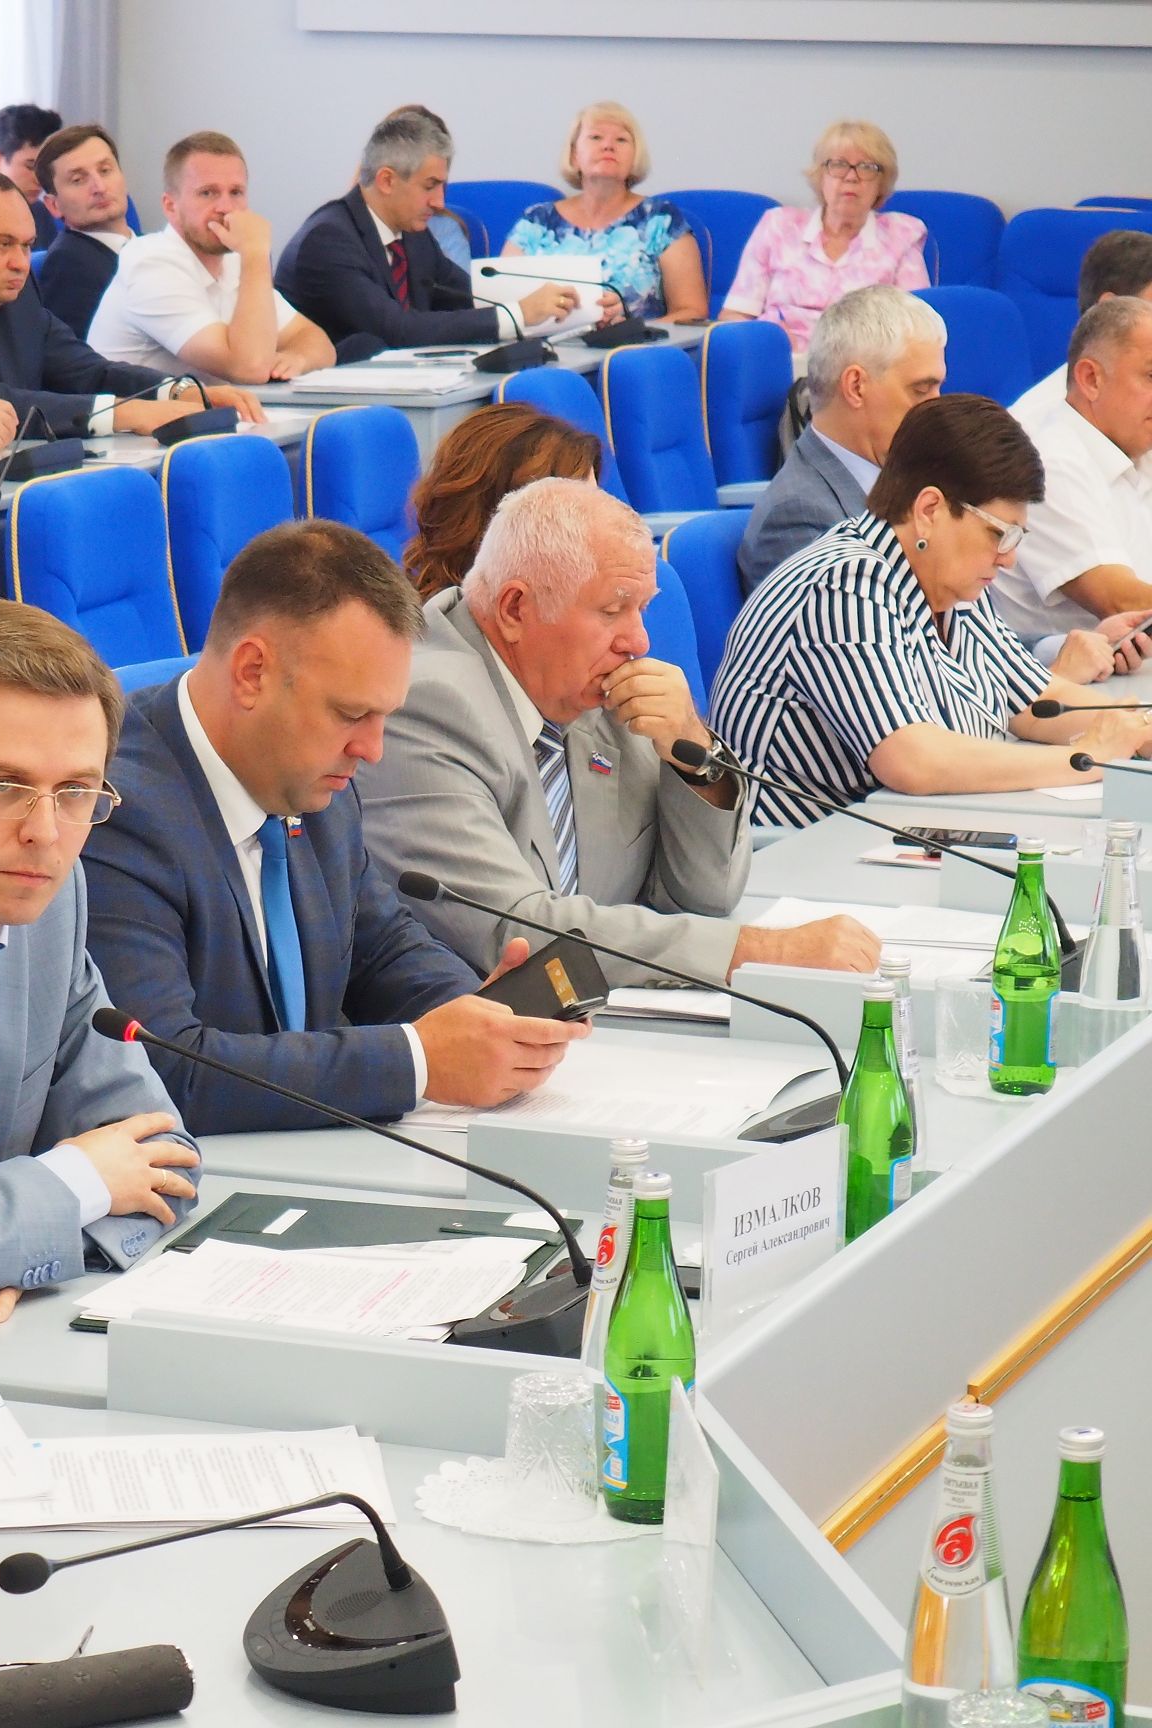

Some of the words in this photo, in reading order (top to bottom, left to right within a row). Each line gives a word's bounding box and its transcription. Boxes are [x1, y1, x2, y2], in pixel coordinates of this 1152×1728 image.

[733, 1186, 821, 1238] ИЗМАЛКОВ
[726, 1240, 758, 1266] Сергей
[761, 1217, 830, 1251] Александрович
